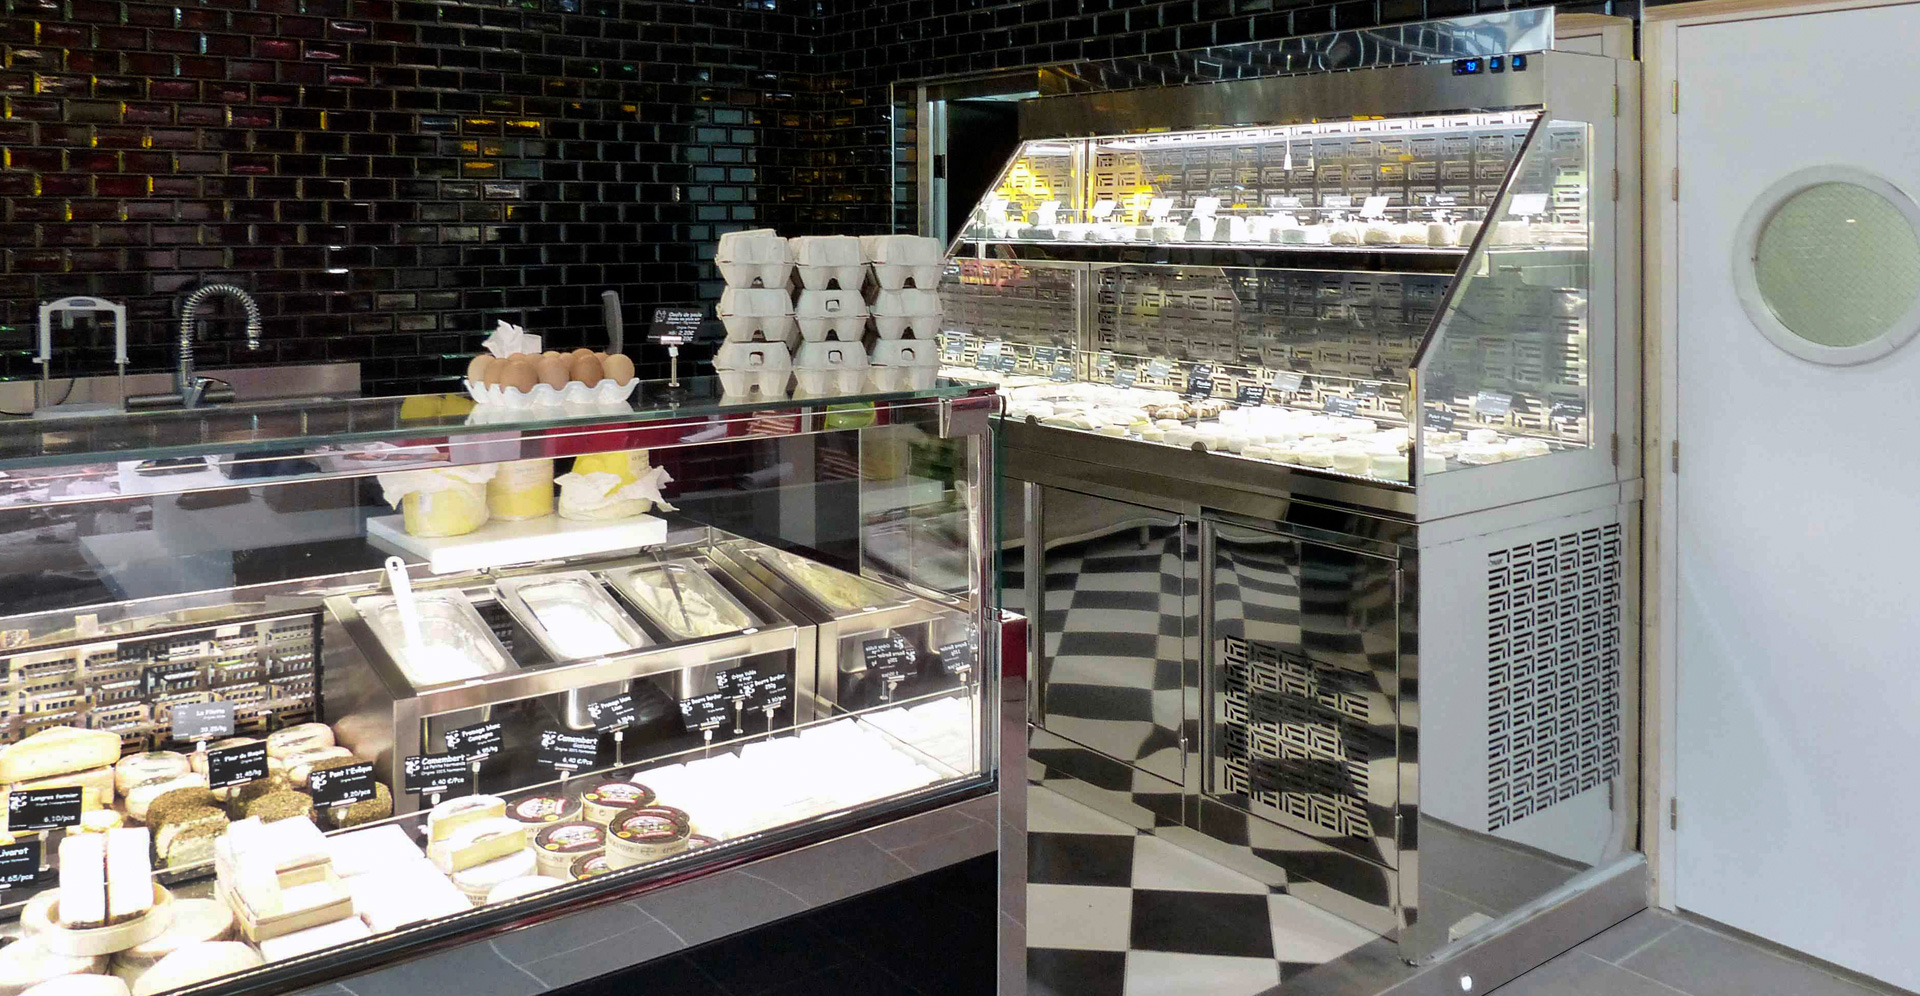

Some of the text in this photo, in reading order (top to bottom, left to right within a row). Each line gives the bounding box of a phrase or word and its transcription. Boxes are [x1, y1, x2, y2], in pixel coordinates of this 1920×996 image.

[601, 700, 620, 710] Fromage
[462, 728, 486, 738] Fromage
[557, 734, 598, 745] Camembert
[421, 753, 465, 765] Camembert
[329, 770, 344, 778] Pont
